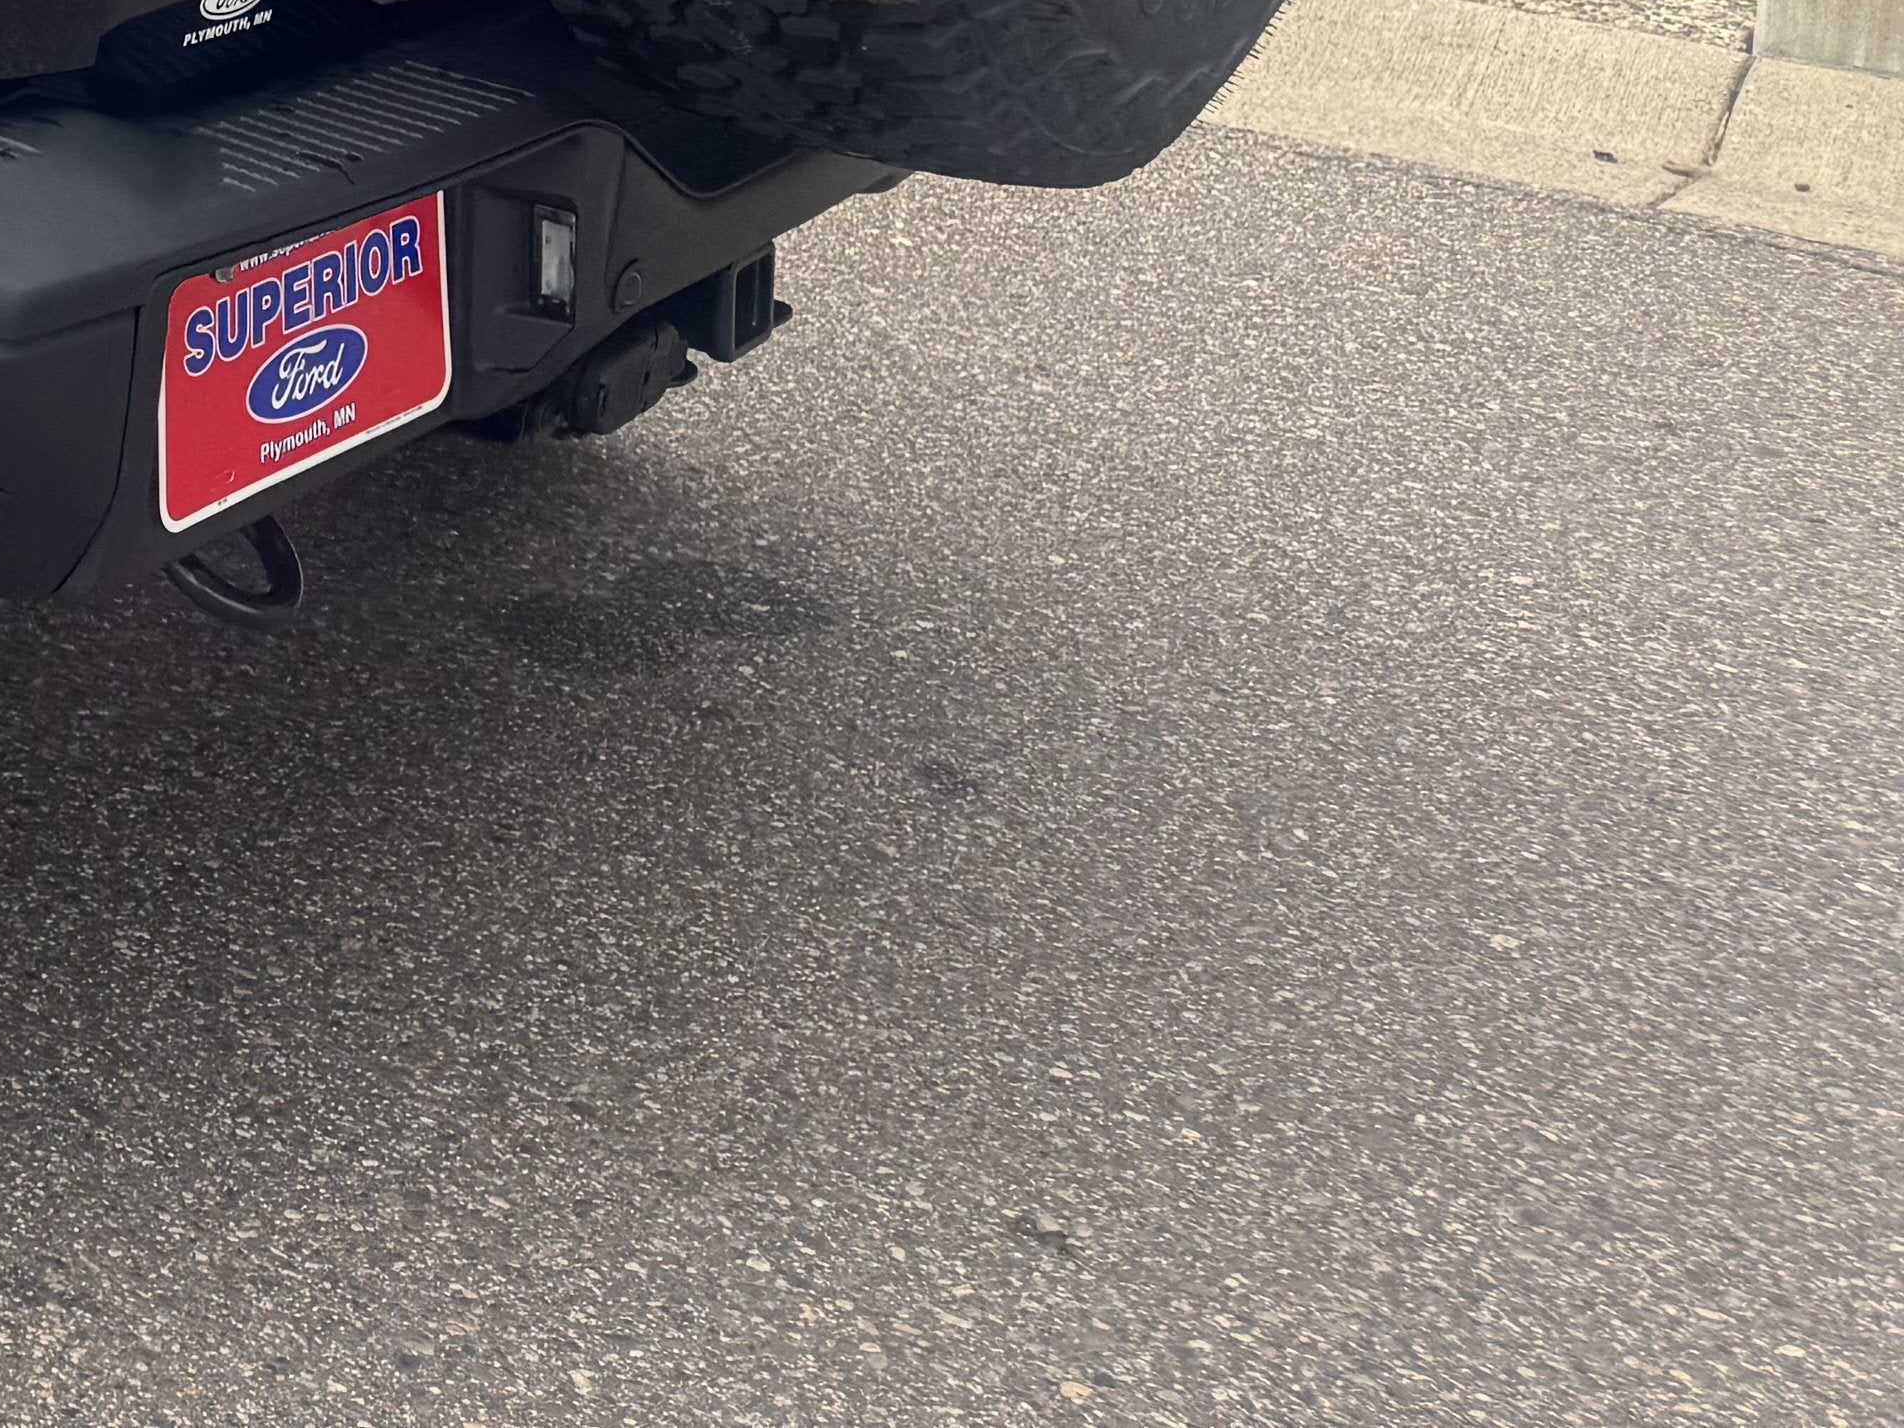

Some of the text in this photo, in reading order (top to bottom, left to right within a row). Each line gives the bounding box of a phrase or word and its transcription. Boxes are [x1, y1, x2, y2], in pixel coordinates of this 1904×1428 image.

[182, 9, 273, 47] PLYMOUTH, MN
[182, 214, 423, 378] SUPERIOR
[271, 338, 346, 411] Ford
[259, 418, 331, 464] Plymouth,
[334, 402, 357, 429] MN
